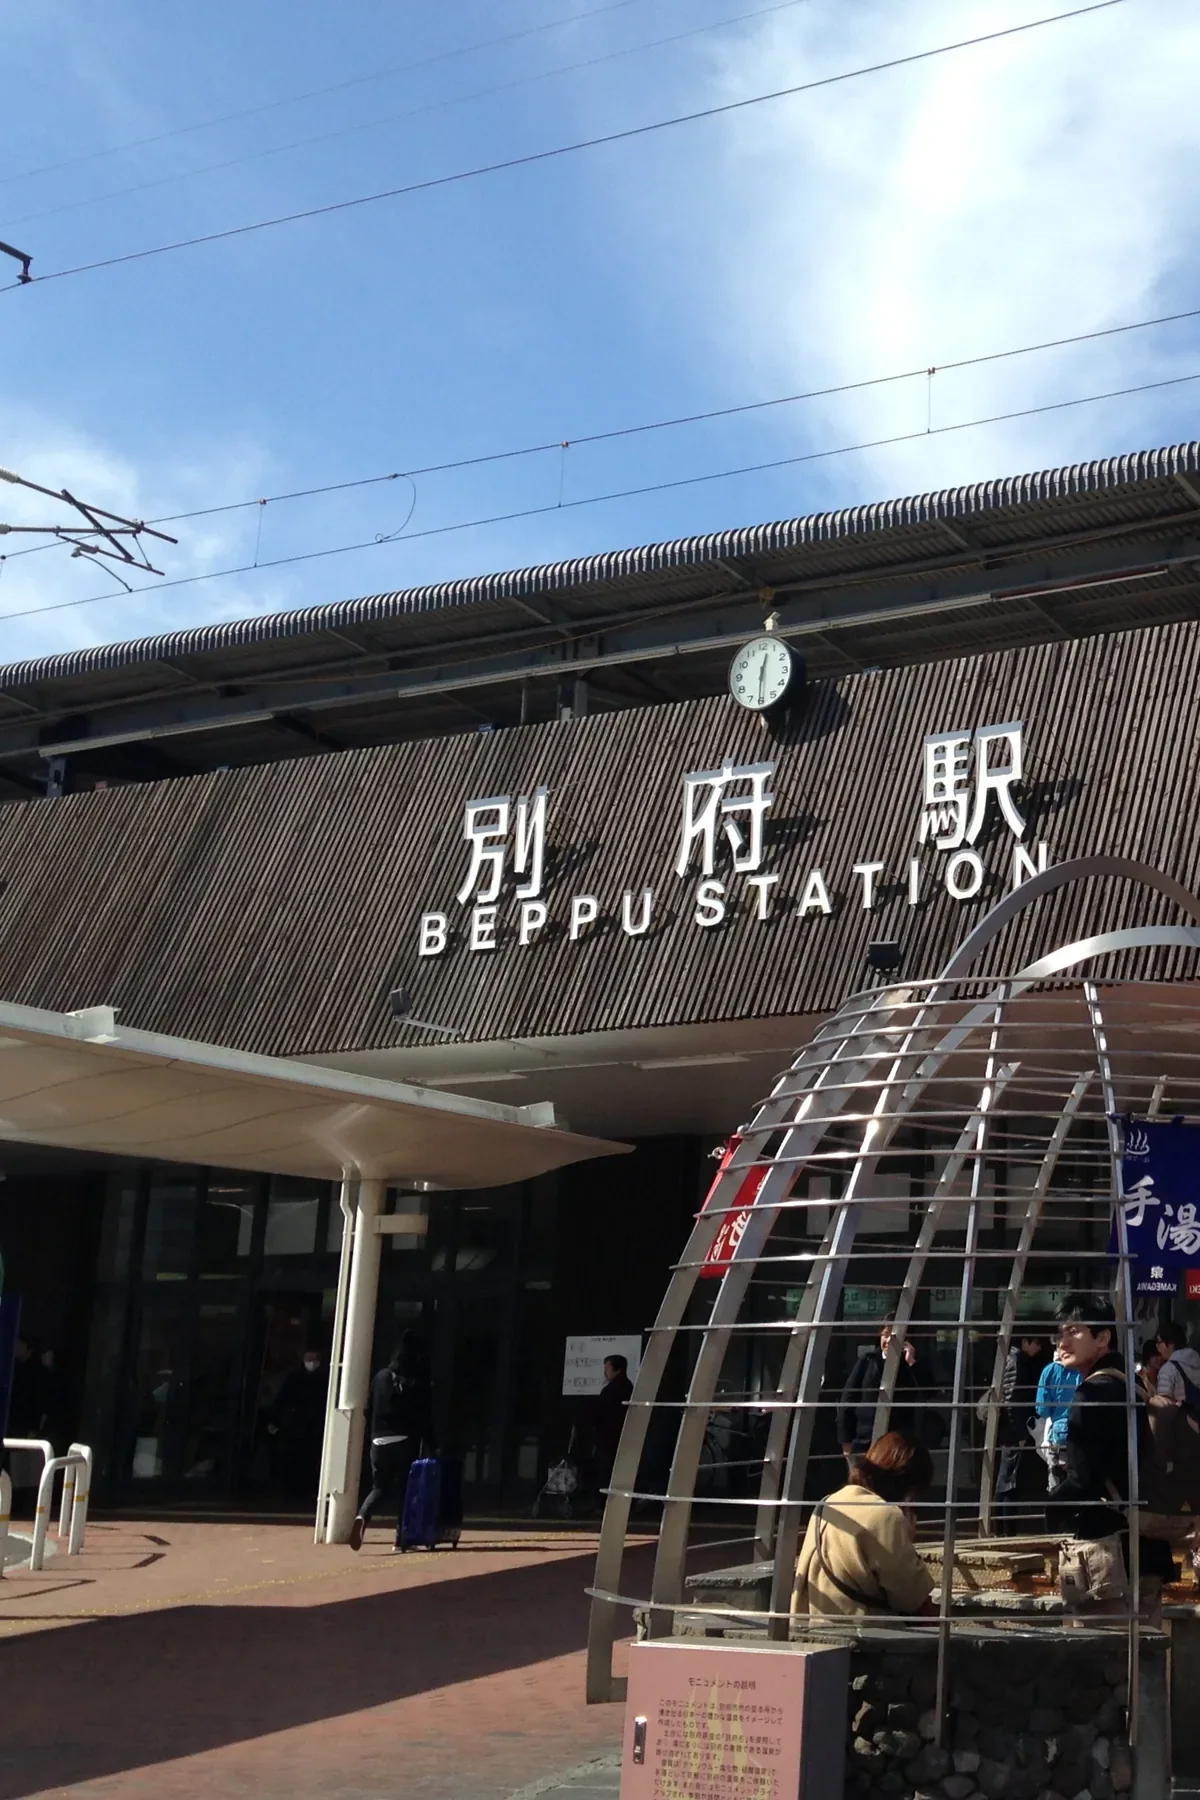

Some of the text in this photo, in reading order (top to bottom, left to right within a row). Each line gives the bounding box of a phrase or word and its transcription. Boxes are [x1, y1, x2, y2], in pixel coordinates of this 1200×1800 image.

[758, 643, 768, 651] 12
[747, 650, 755, 658] 11
[779, 653, 786, 661] 2
[739, 661, 748, 669] 10
[781, 666, 789, 674] 3
[735, 673, 743, 682] 9
[777, 678, 785, 686] 4
[738, 685, 746, 694] 8
[769, 690, 777, 699] 5
[747, 695, 754, 703] 7
[757, 696, 765, 705] 6
[456, 721, 1027, 905] 別府駅
[418, 840, 1051, 957] BEPPU STATION
